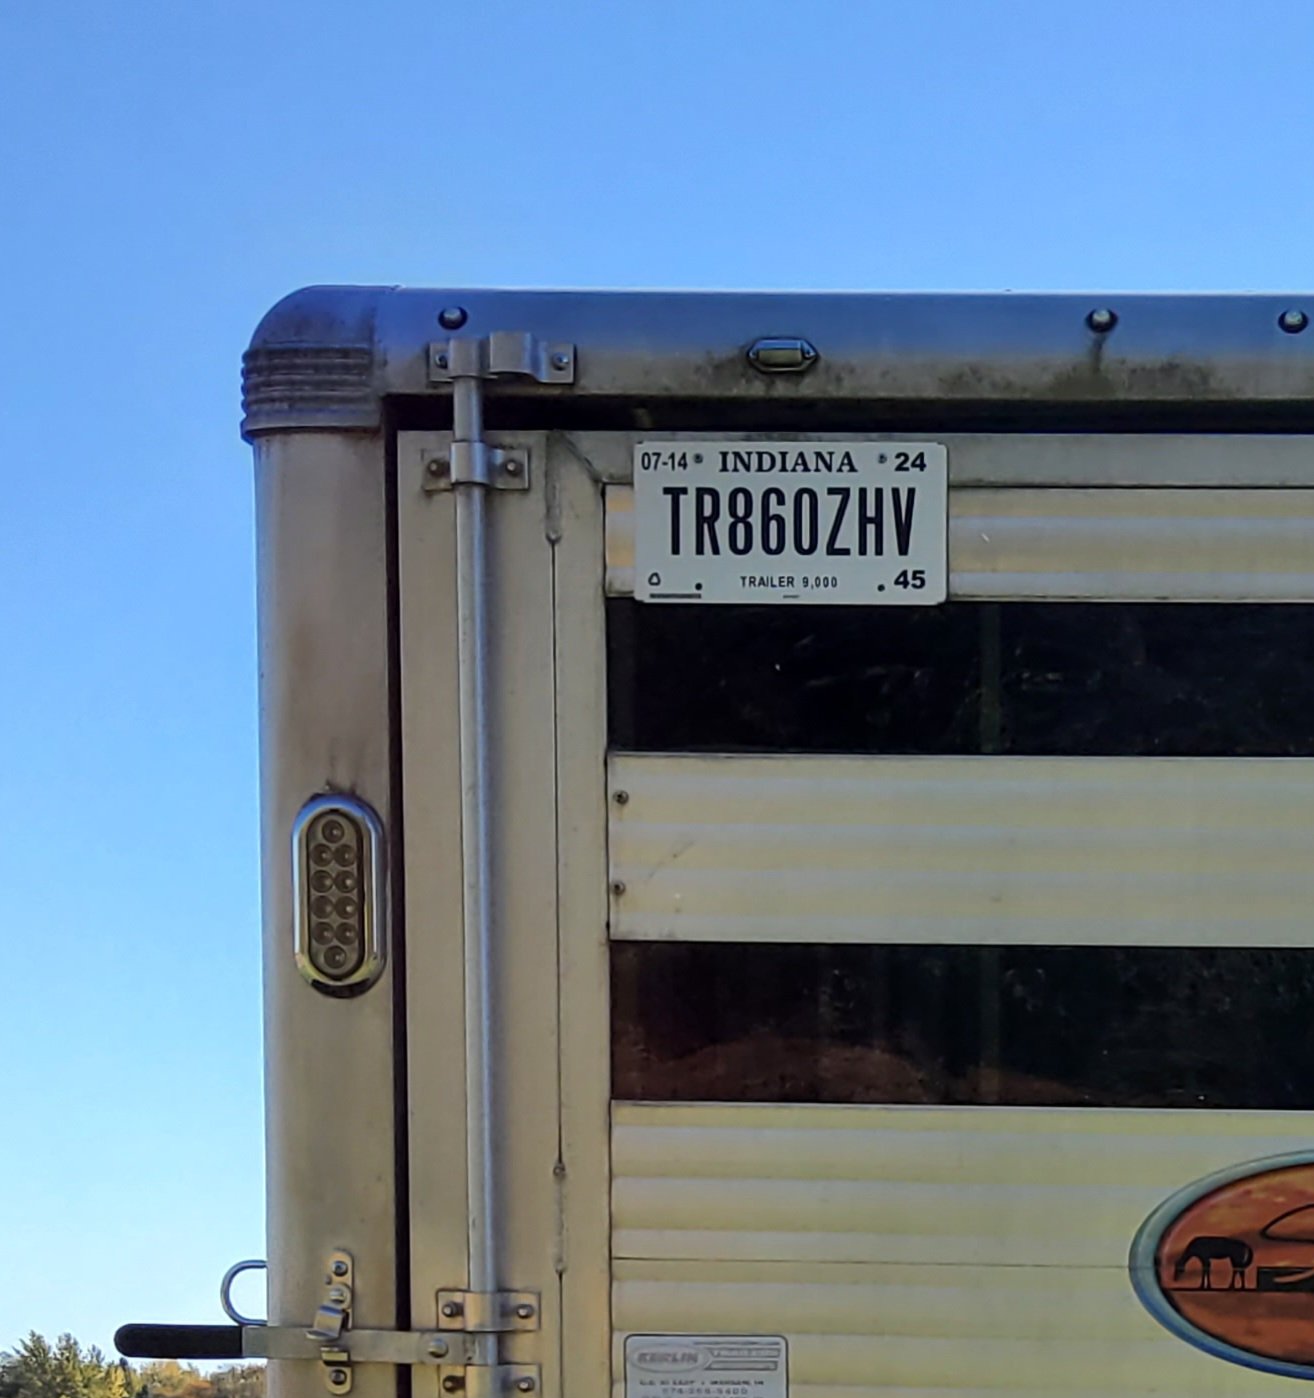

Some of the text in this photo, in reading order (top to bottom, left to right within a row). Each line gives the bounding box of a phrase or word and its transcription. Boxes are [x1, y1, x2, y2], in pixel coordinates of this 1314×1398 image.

[641, 451, 927, 473] 07-14 INDIANA 24
[662, 486, 916, 556] TR860ZHV
[740, 575, 838, 589] TRAILER 9,000
[893, 569, 927, 590] 45
